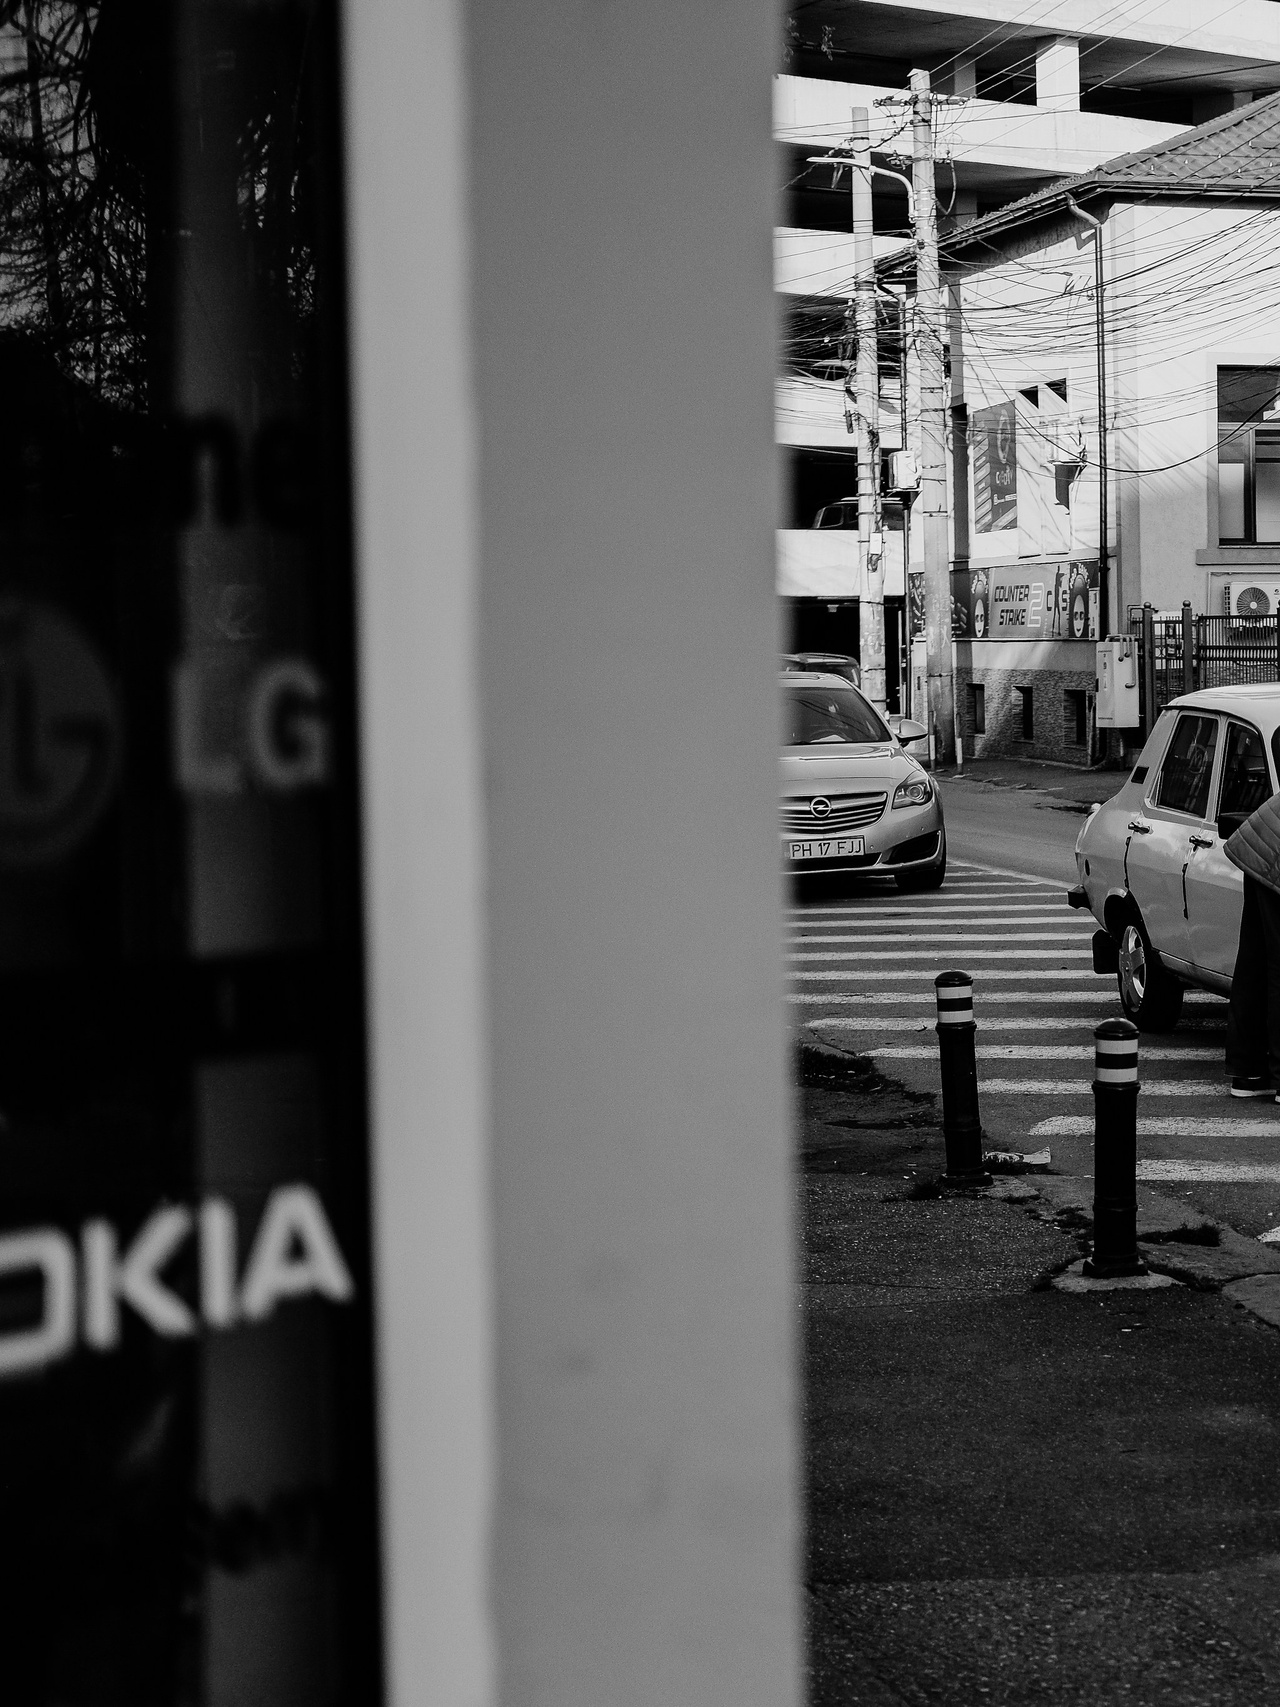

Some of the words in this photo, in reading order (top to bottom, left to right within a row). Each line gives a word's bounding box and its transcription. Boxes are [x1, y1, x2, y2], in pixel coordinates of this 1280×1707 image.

[994, 585, 1029, 602] COUNTER
[999, 609, 1026, 626] STRIKE
[169, 655, 334, 795] LG
[792, 844, 812, 857] PH
[818, 842, 830, 856] 17
[837, 840, 861, 854] FJJ
